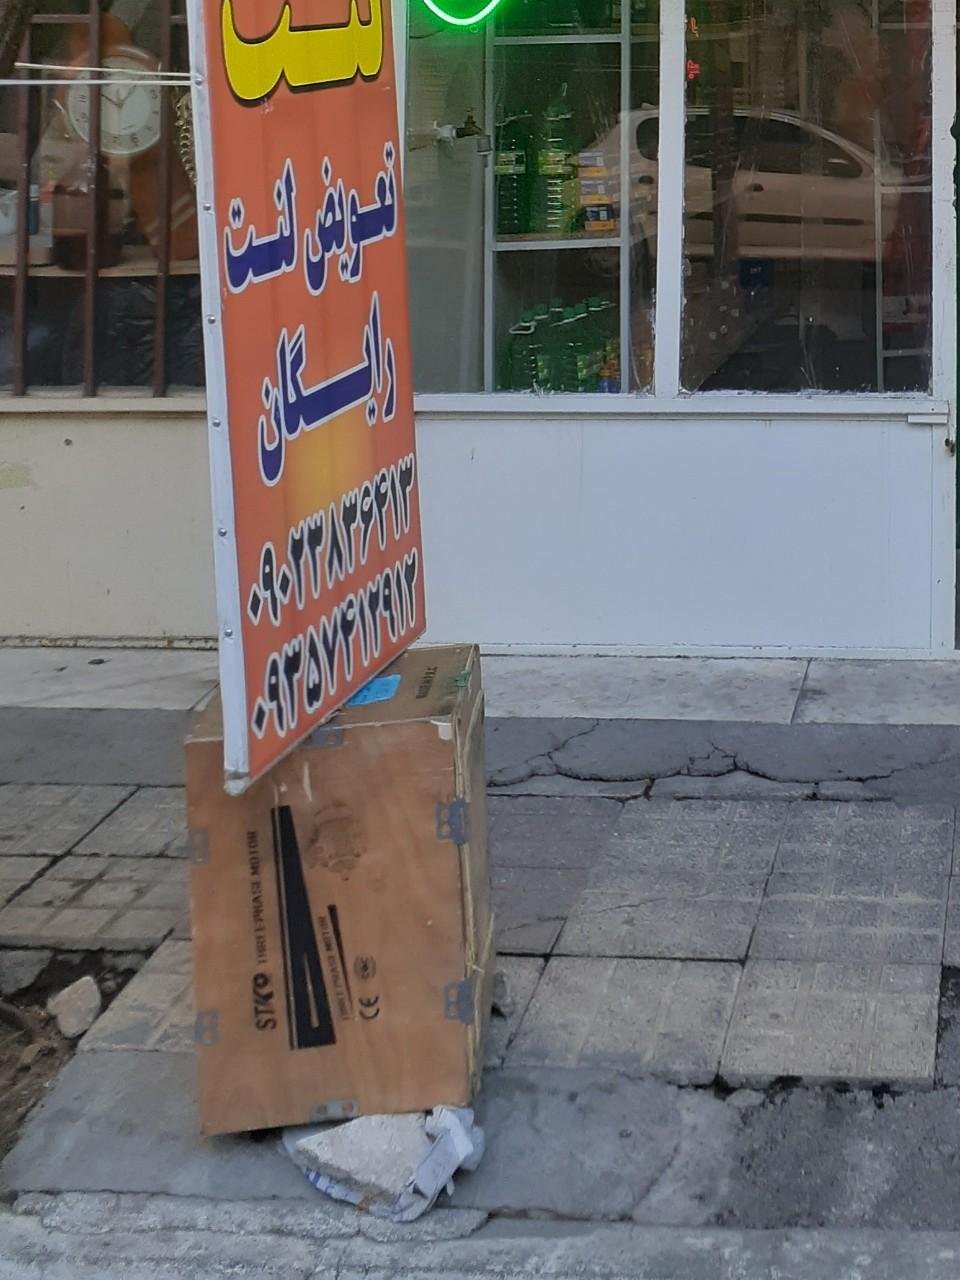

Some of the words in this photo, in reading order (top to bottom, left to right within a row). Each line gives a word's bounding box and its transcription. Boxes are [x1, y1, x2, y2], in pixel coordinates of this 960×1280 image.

[223, 157, 298, 294] لنت
[304, 141, 398, 295] تعویض
[256, 291, 396, 487] رایگان
